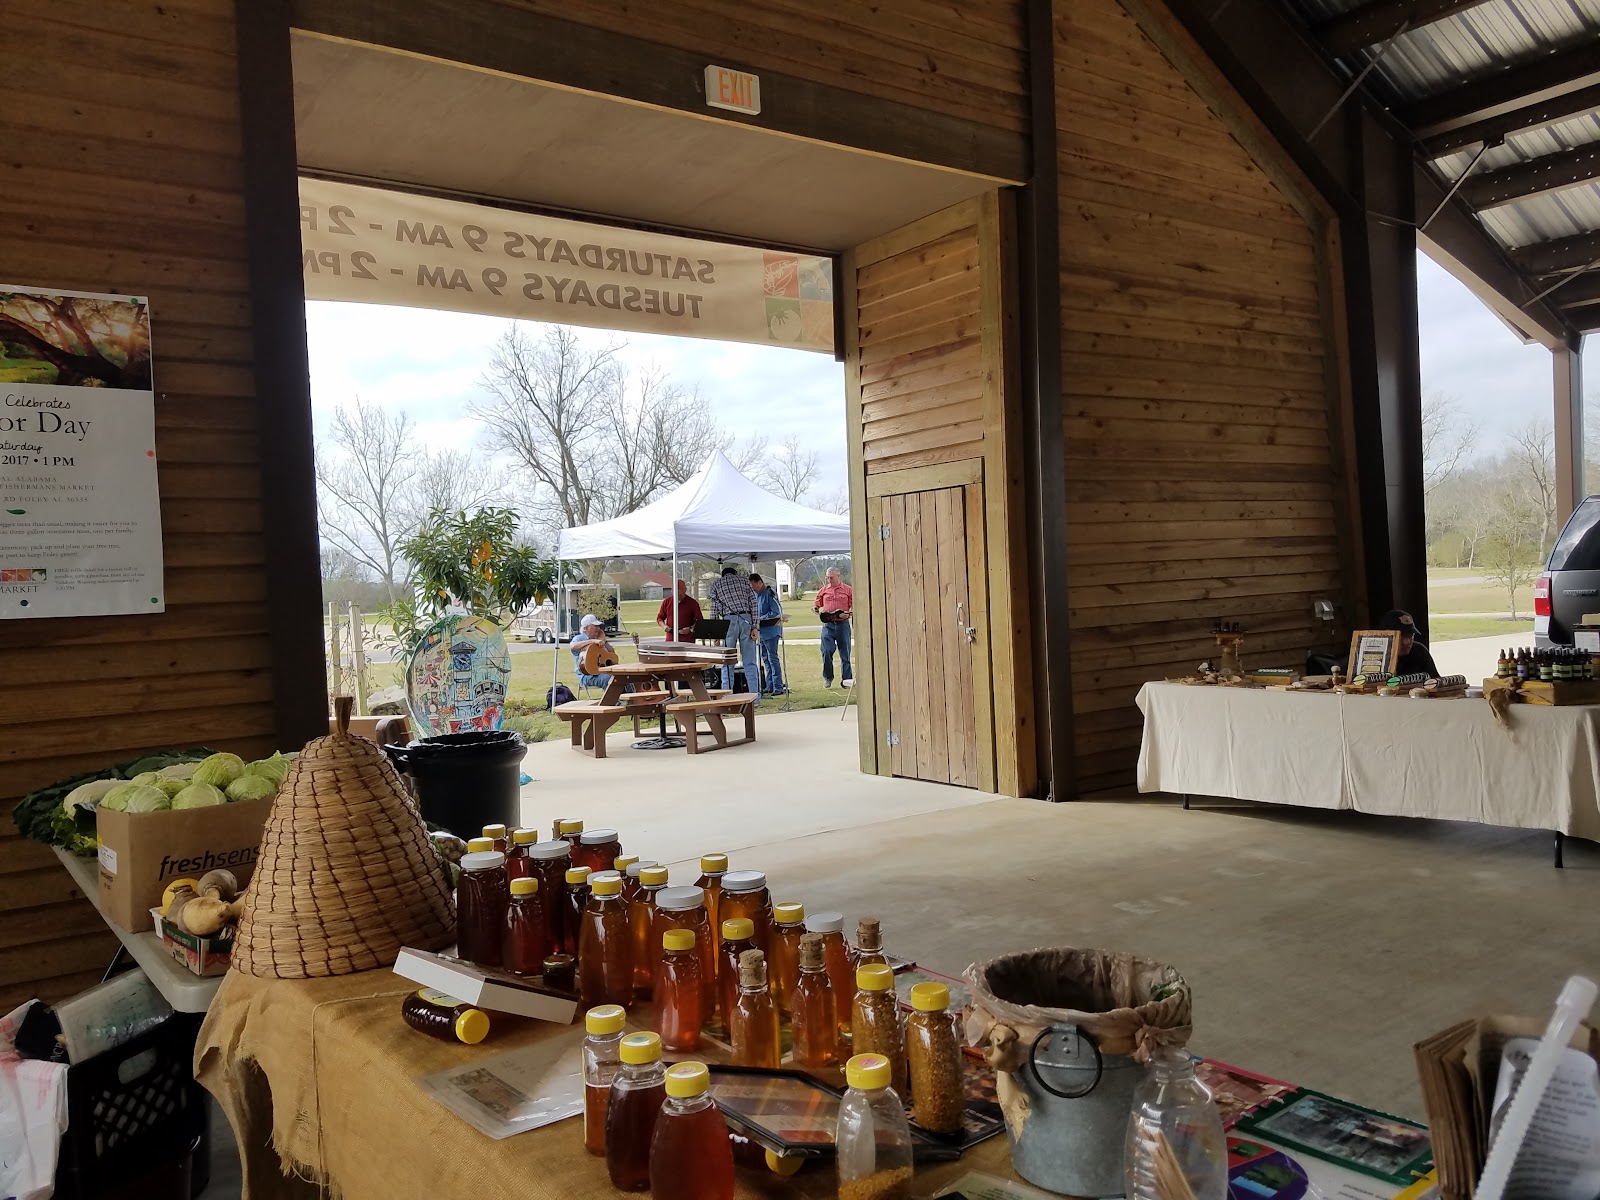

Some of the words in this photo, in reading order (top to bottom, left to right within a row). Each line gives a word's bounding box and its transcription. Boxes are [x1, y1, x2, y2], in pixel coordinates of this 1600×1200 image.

[719, 69, 753, 108] EXIT
[5, 393, 71, 410] Celebrates
[36, 411, 92, 442] Day
[2, 455, 29, 466] 2017
[42, 456, 48, 466] 1
[53, 456, 76, 467] PM
[64, 521, 87, 529] making
